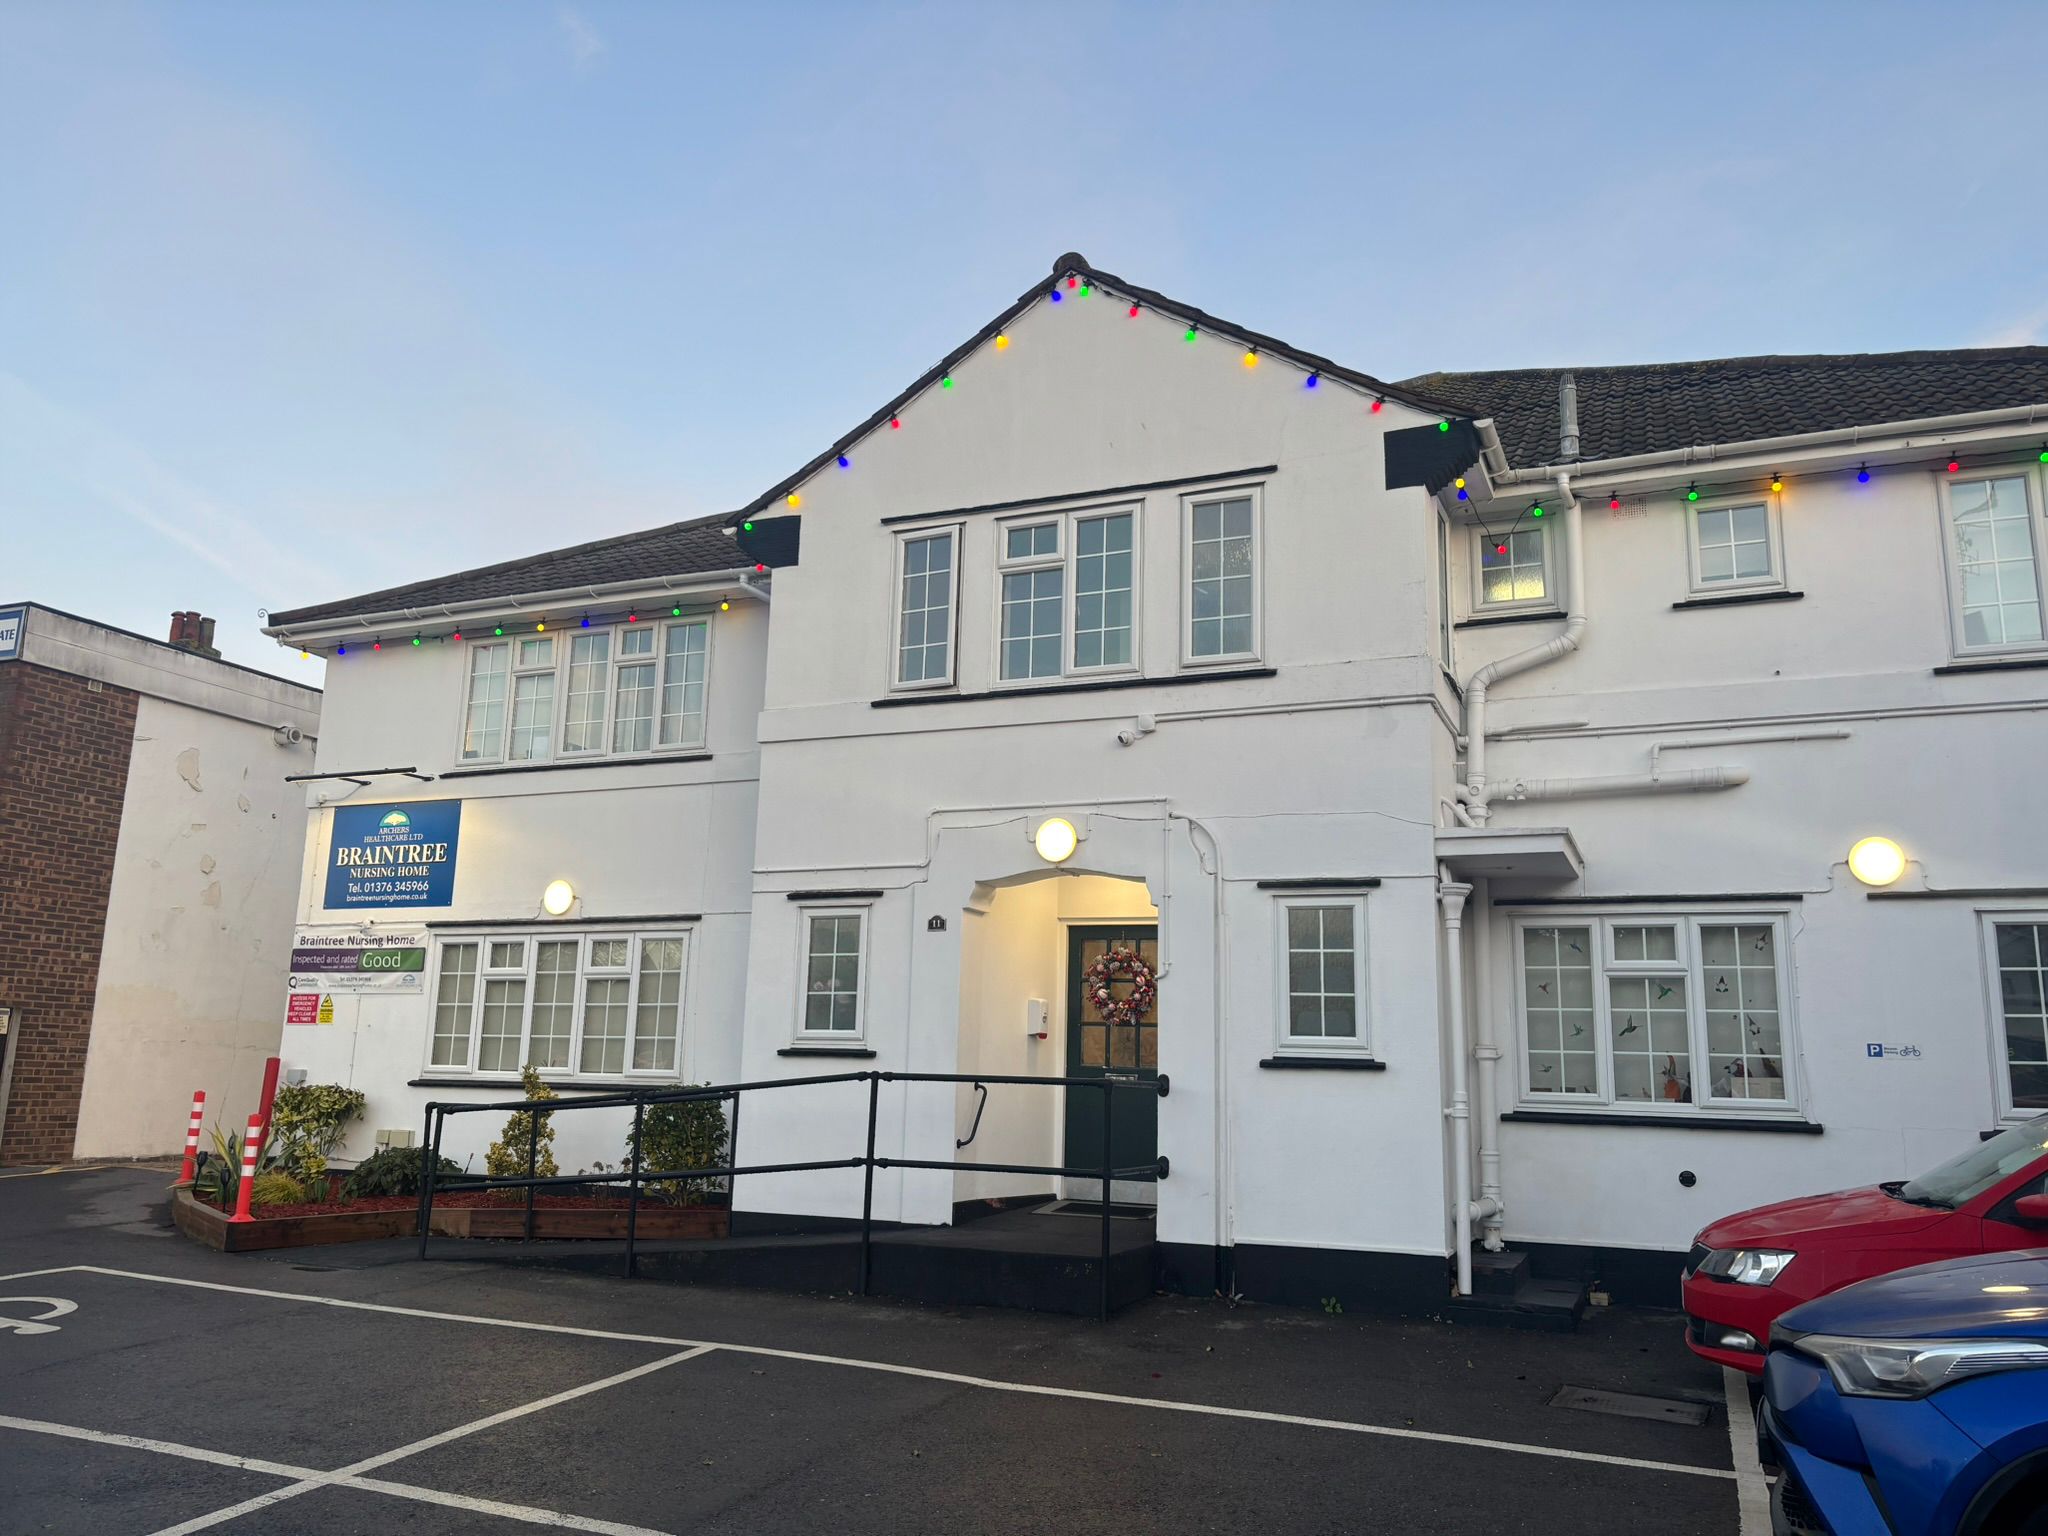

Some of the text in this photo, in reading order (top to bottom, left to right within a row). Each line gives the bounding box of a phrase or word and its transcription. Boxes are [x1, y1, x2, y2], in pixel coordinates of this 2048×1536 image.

[0, 629, 15, 640] ATE
[363, 834, 408, 843] HEALTHCARE
[336, 843, 448, 866] BRAINTREE
[350, 865, 430, 879] NURSING HOME
[348, 881, 429, 893] Tel. 01376 345966
[346, 892, 428, 902] braintreenursinghome.co.uk
[300, 935, 415, 947] Braintree Nursing Home
[293, 954, 359, 966] Inspected and rated
[362, 952, 401, 968] Good
[1871, 1045, 1880, 1056] P
